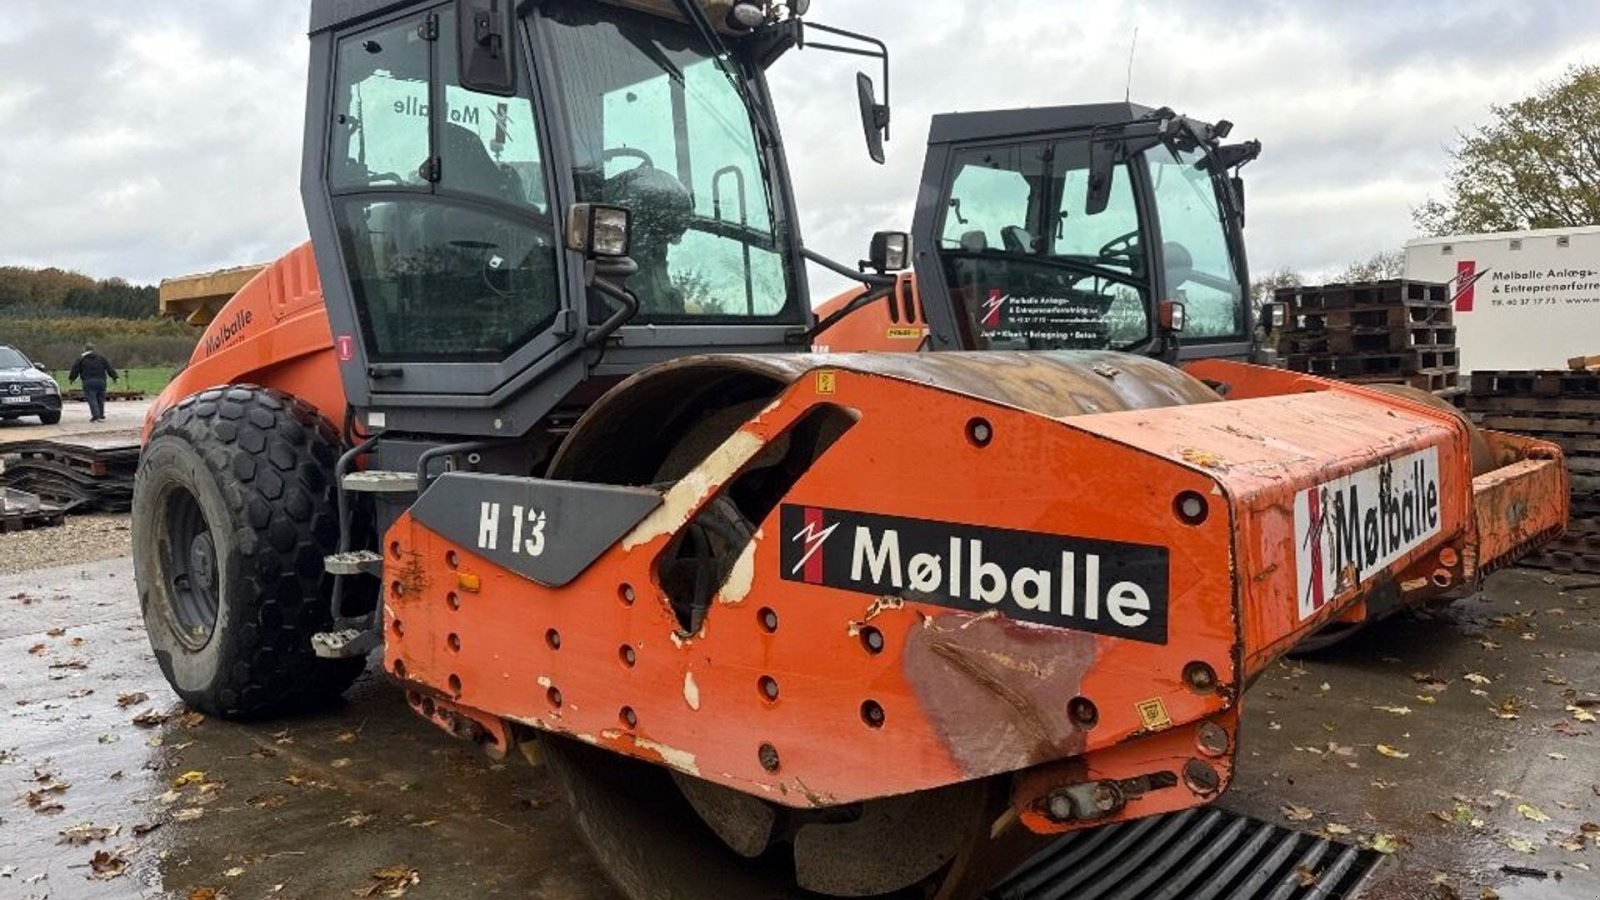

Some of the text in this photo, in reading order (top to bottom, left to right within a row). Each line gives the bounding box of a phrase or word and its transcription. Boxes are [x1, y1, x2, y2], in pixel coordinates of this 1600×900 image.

[1492, 285, 1500, 294] &
[206, 309, 252, 357] Mølballe
[478, 501, 547, 556] H 13
[851, 526, 1151, 628] Mølballe
